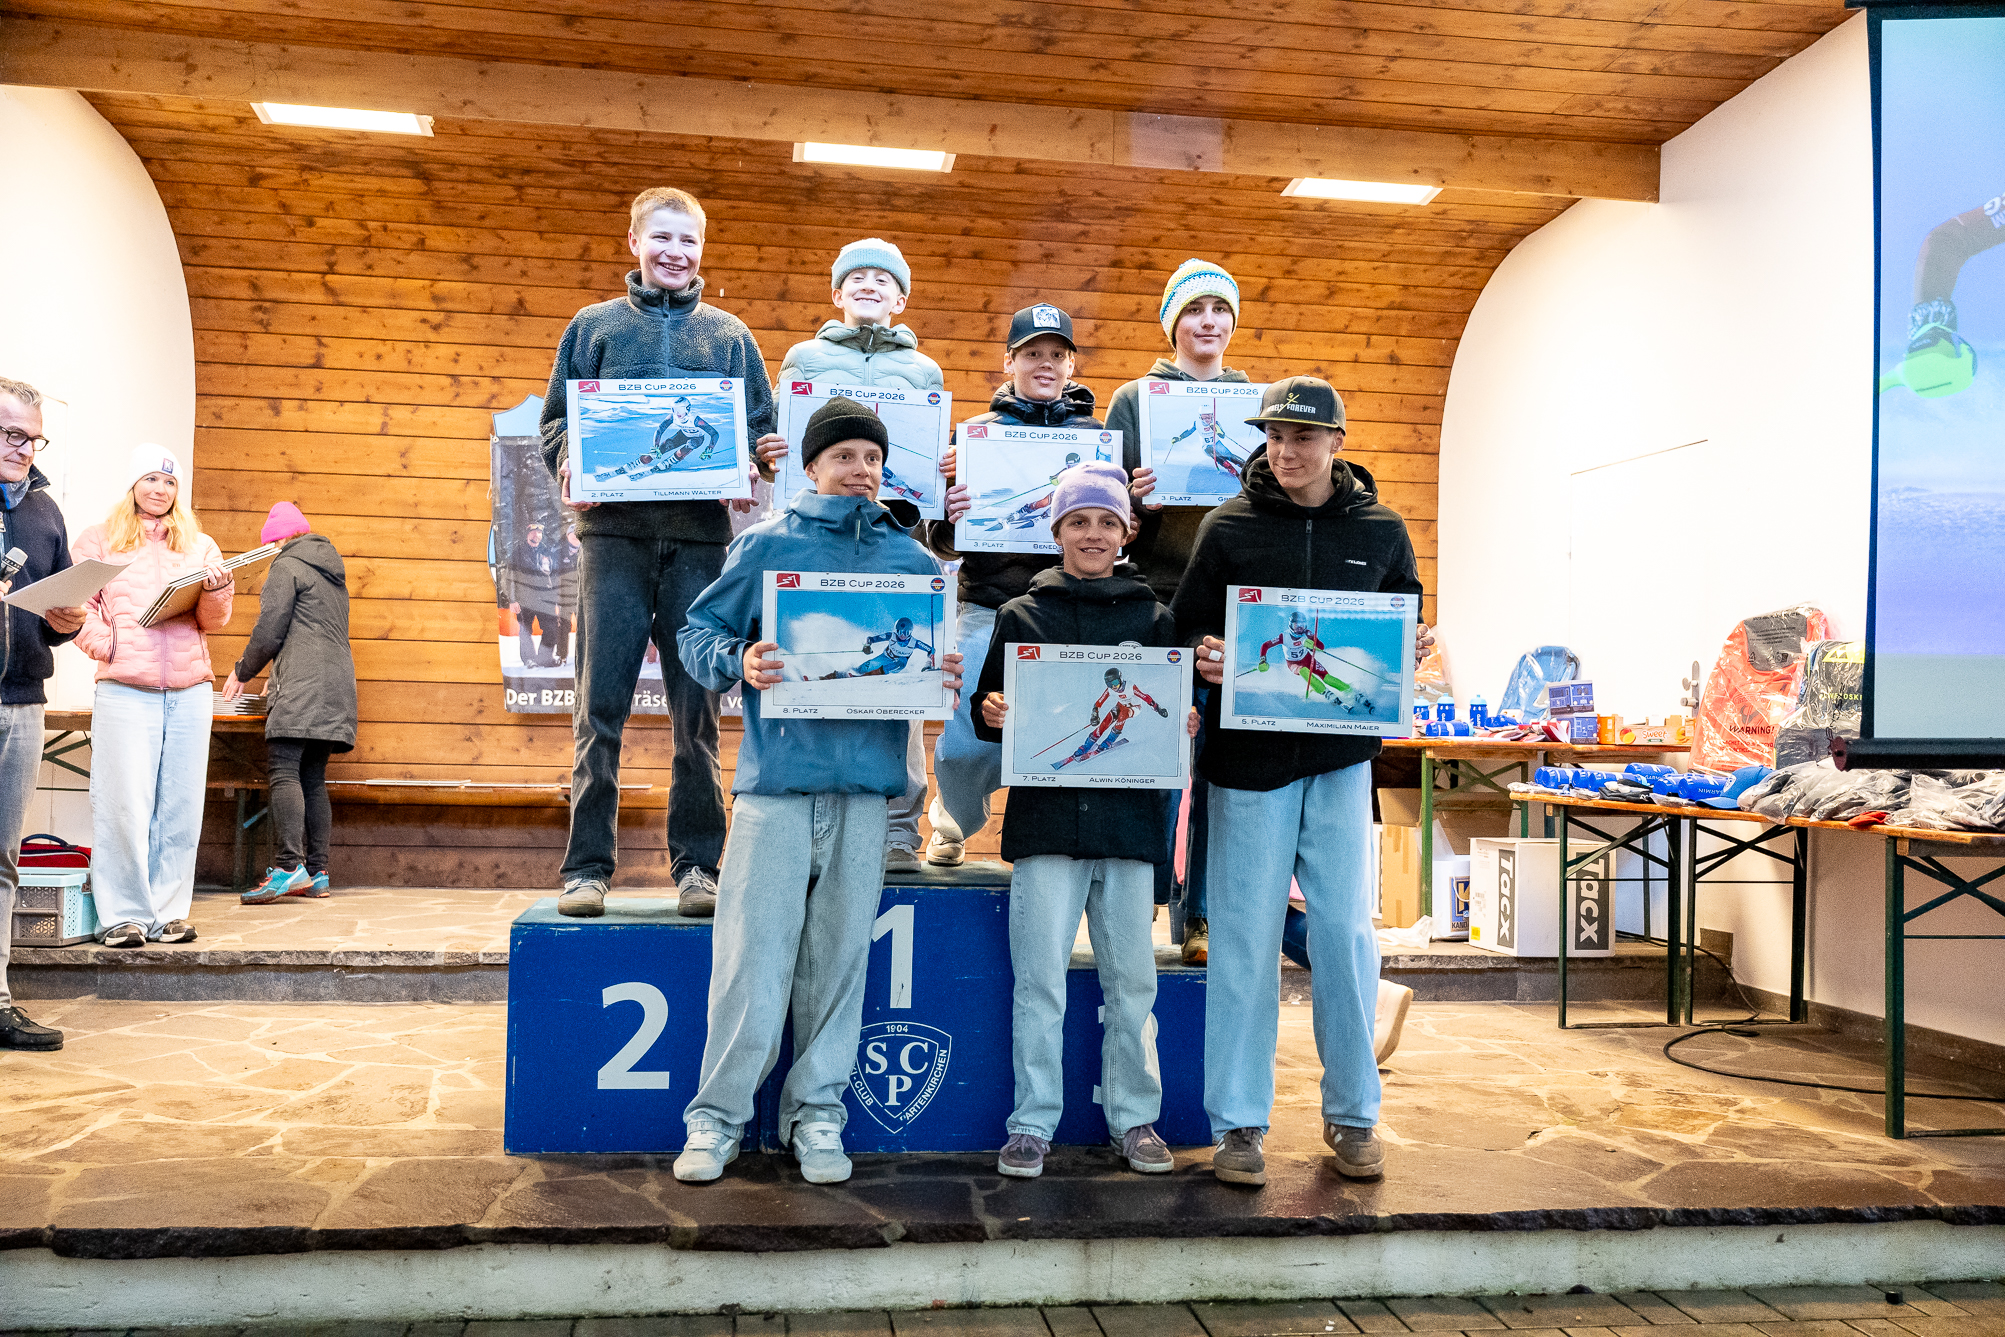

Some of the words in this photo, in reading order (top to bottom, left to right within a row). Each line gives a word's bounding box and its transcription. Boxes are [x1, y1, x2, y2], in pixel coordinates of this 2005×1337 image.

[669, 383, 697, 391] 2026
[1186, 386, 1209, 394] BZB
[1233, 388, 1259, 396] 2026
[830, 388, 853, 397] BZB
[878, 392, 905, 401] 2026
[1286, 403, 1316, 414] FOREVER
[1004, 430, 1027, 439] BZB
[1051, 433, 1078, 441] 2026
[820, 578, 846, 587] BZB
[875, 580, 906, 589] 2026
[1281, 594, 1305, 603] BZB
[1335, 597, 1365, 606] 2026
[1059, 651, 1085, 660] BZB
[1113, 653, 1143, 661] 2026
[506, 688, 537, 706] Der
[541, 688, 576, 706] BZB
[1641, 729, 1668, 740] Sweet
[1729, 725, 1775, 735] WARNING!
[1500, 856, 1514, 942] Tacx
[1580, 858, 1605, 944] Tacx
[1451, 921, 1470, 929] KAND
[870, 904, 915, 1009] 1
[885, 1024, 909, 1033] 1904
[597, 981, 670, 1090] 2
[885, 1074, 912, 1106] P
[899, 1049, 948, 1121] ARTENKIRCHEN
